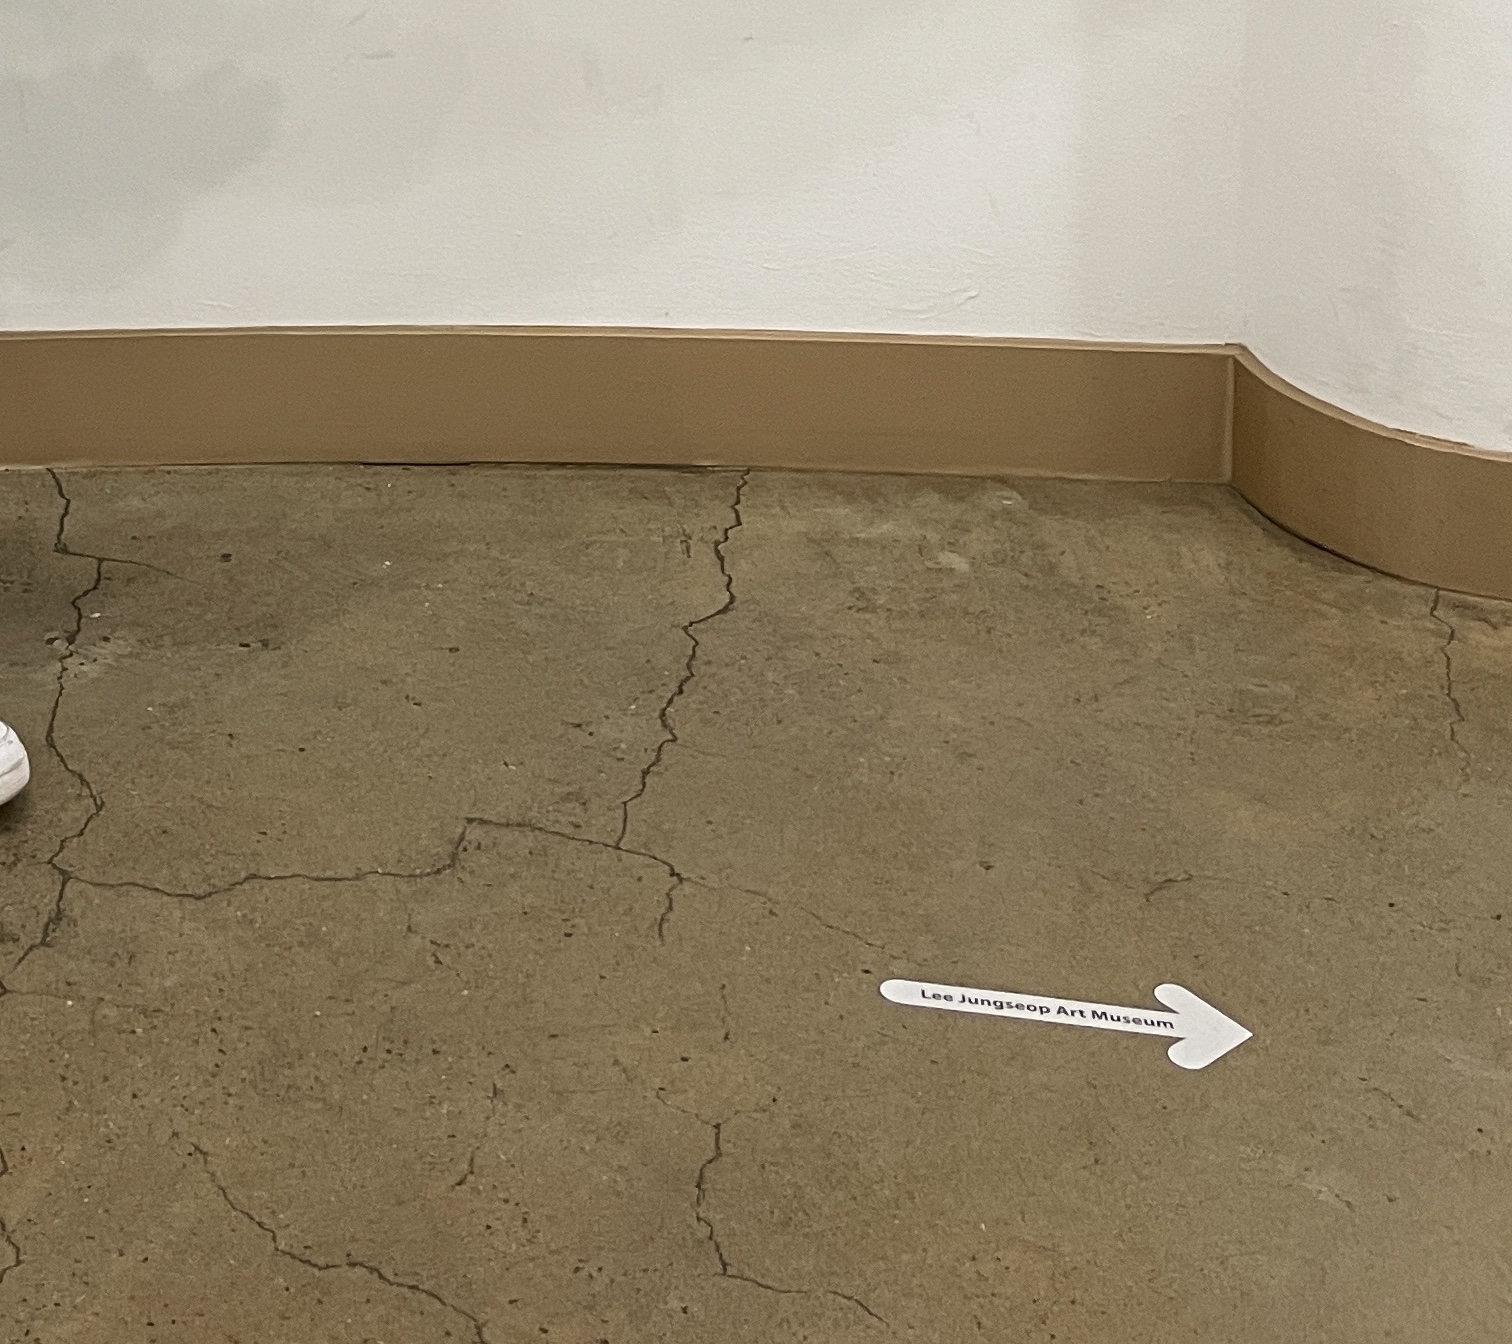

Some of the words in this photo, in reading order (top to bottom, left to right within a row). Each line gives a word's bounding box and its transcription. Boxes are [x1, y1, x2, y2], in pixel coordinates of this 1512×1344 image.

[921, 988, 954, 1002] Lee
[958, 993, 1051, 1016] Jungseop
[1056, 1005, 1087, 1019] Art
[1091, 1009, 1175, 1030] Museum
